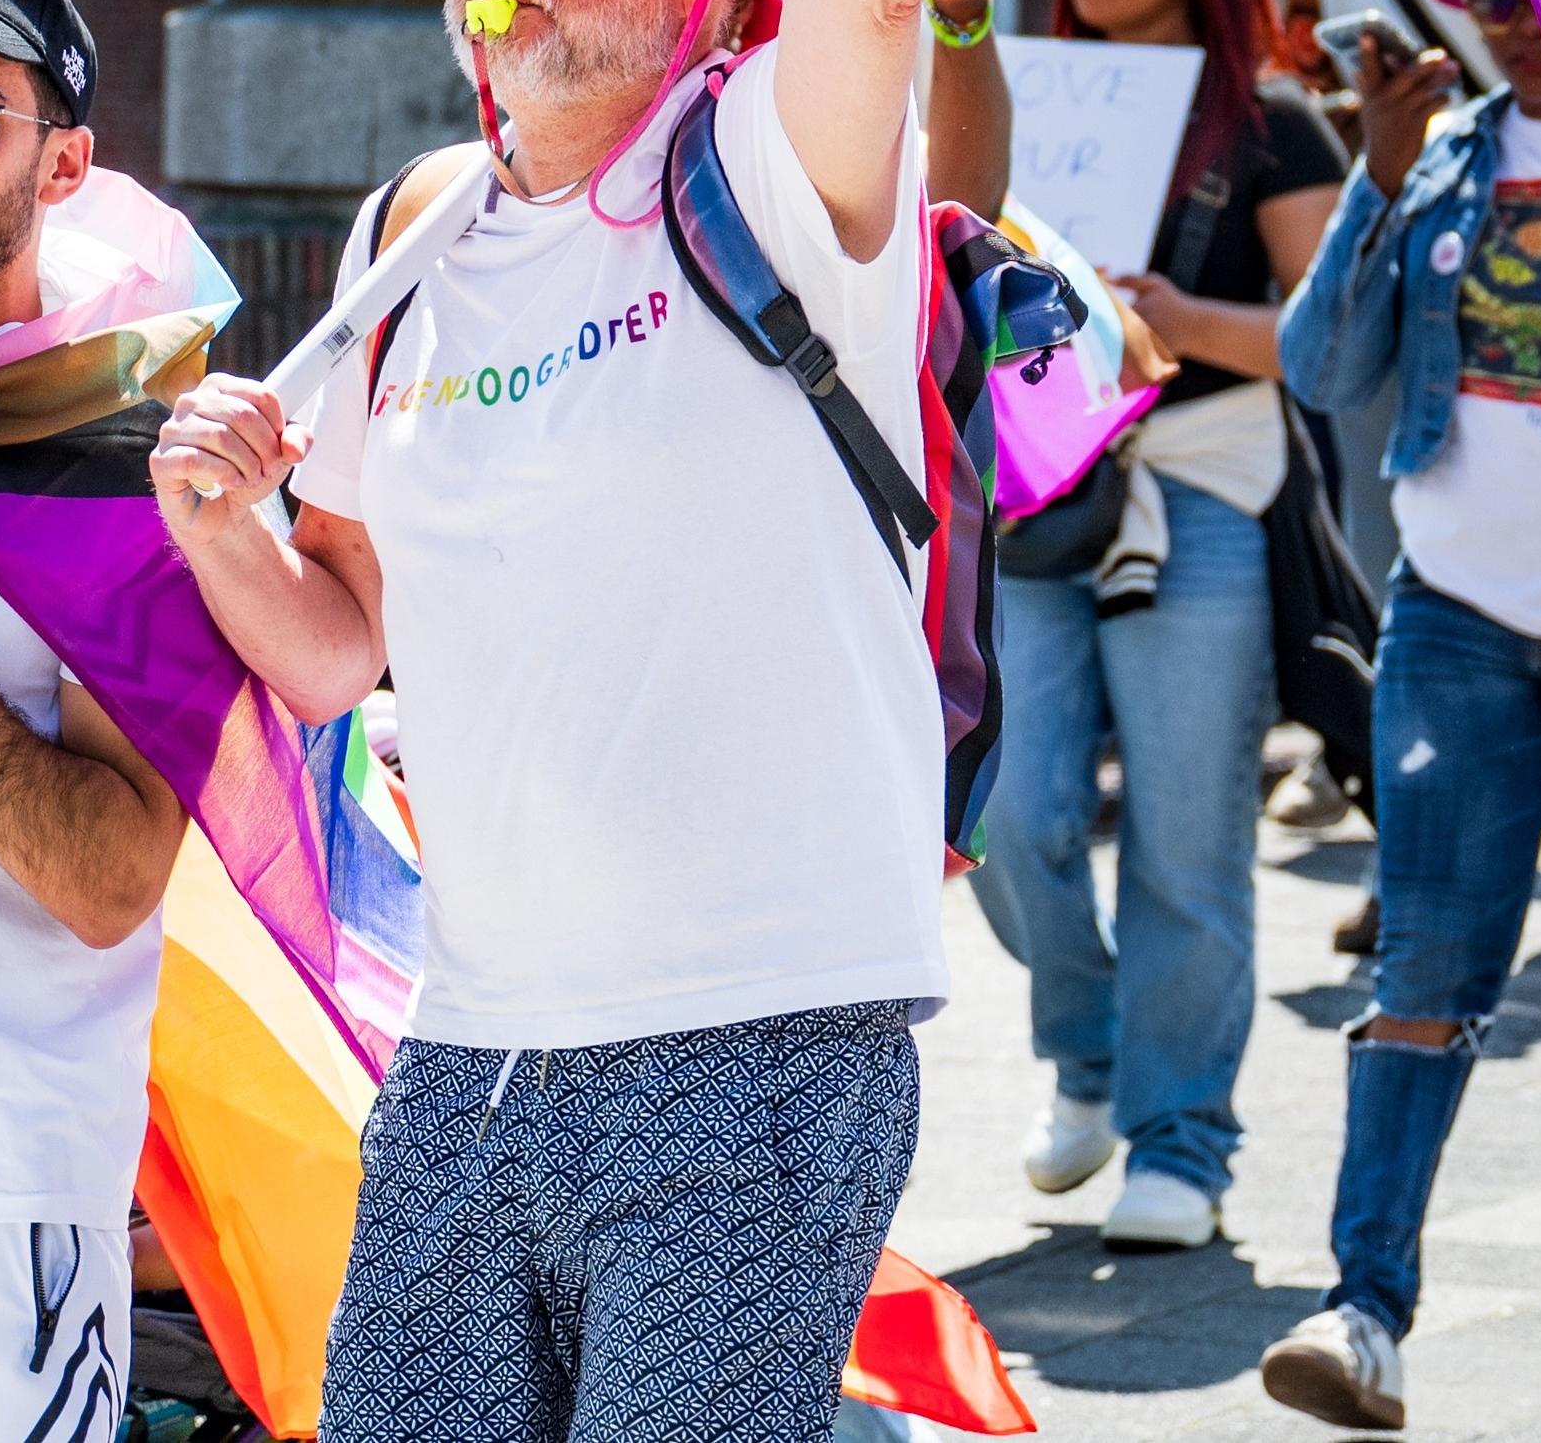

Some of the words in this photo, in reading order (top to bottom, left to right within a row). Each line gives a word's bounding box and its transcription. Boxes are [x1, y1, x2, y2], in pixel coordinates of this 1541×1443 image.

[61, 48, 87, 90] NORTH
[70, 44, 85, 72] THE
[63, 65, 81, 97] FACE
[1013, 57, 1146, 110] OVE
